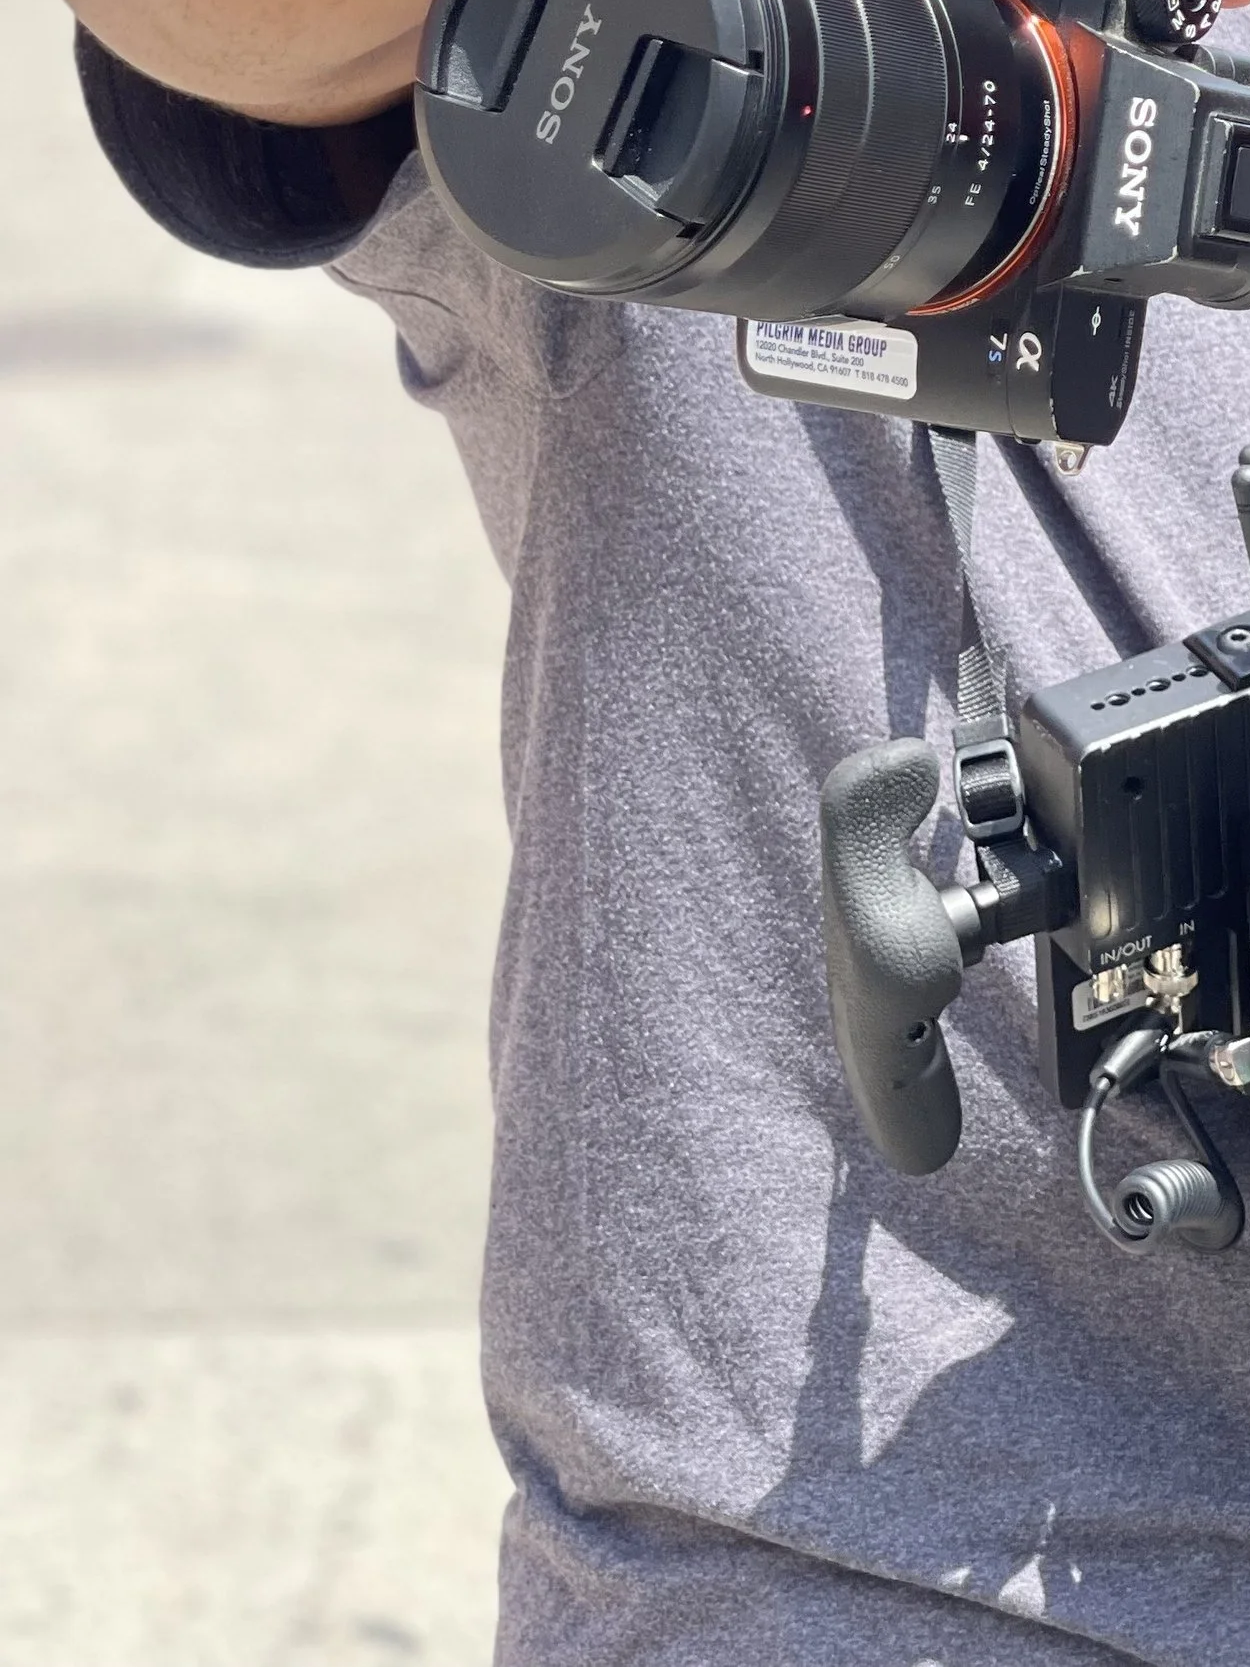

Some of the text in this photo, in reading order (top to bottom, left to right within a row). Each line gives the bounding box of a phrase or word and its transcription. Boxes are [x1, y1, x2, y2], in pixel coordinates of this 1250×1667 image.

[1171, 8, 1186, 31] M
[1185, 24, 1197, 39] S
[1200, 17, 1212, 30] A
[536, 3, 602, 145] SONY
[946, 122, 958, 143] 24
[965, 80, 996, 207] FE 4/24-70
[1114, 96, 1157, 236] SONY
[928, 185, 942, 205] 35
[756, 321, 887, 358] PILGRIM MEDIA GROUP
[755, 352, 776, 364] North
[776, 354, 816, 372] Hollywood,
[817, 364, 829, 374] CA
[829, 364, 852, 377] 91607
[855, 369, 861, 379] T
[861, 370, 875, 381] 818
[756, 340, 777, 352] 12020
[778, 343, 809, 358] Chandler
[831, 354, 850, 365] Suite
[850, 356, 864, 367] 200
[1179, 920, 1195, 935] IN
[1100, 935, 1153, 965] IN/OUT
